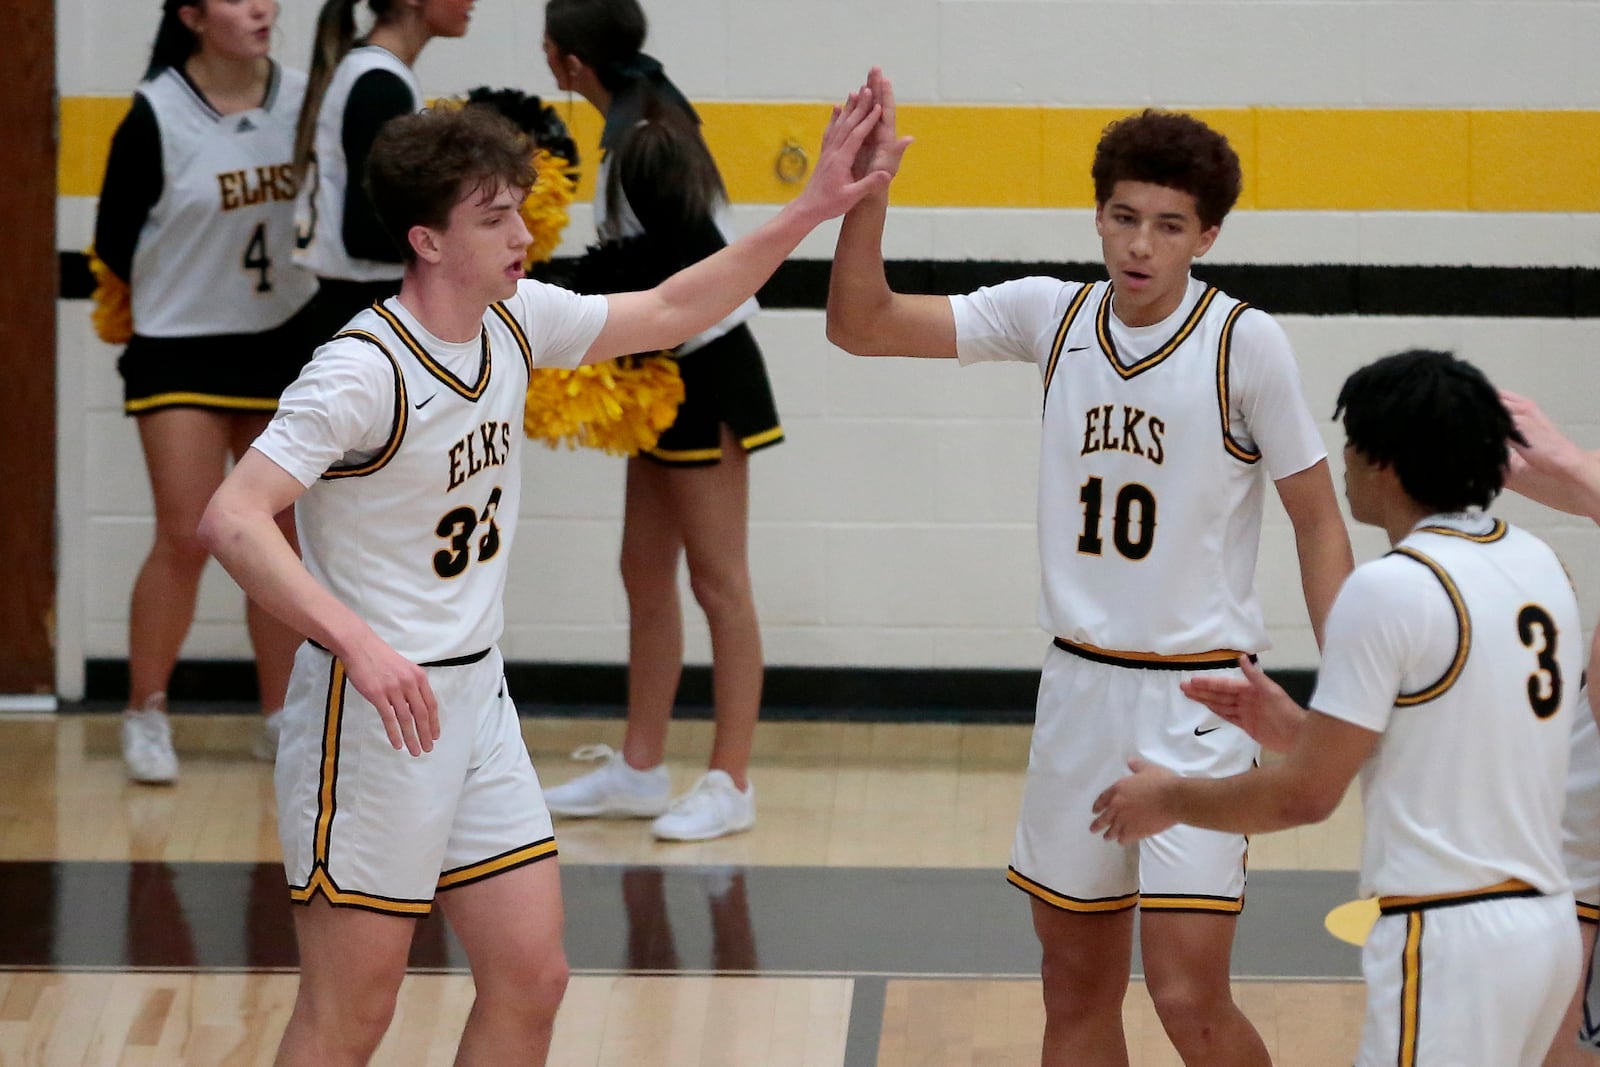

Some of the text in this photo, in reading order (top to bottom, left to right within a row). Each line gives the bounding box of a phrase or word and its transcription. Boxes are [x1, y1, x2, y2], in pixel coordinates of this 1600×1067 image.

[217, 164, 297, 210] ELKS
[242, 221, 271, 292] 4
[446, 421, 510, 493] ELKS
[1080, 405, 1165, 466] ELKS
[1077, 475, 1157, 561] 10
[1518, 603, 1563, 721] 3
